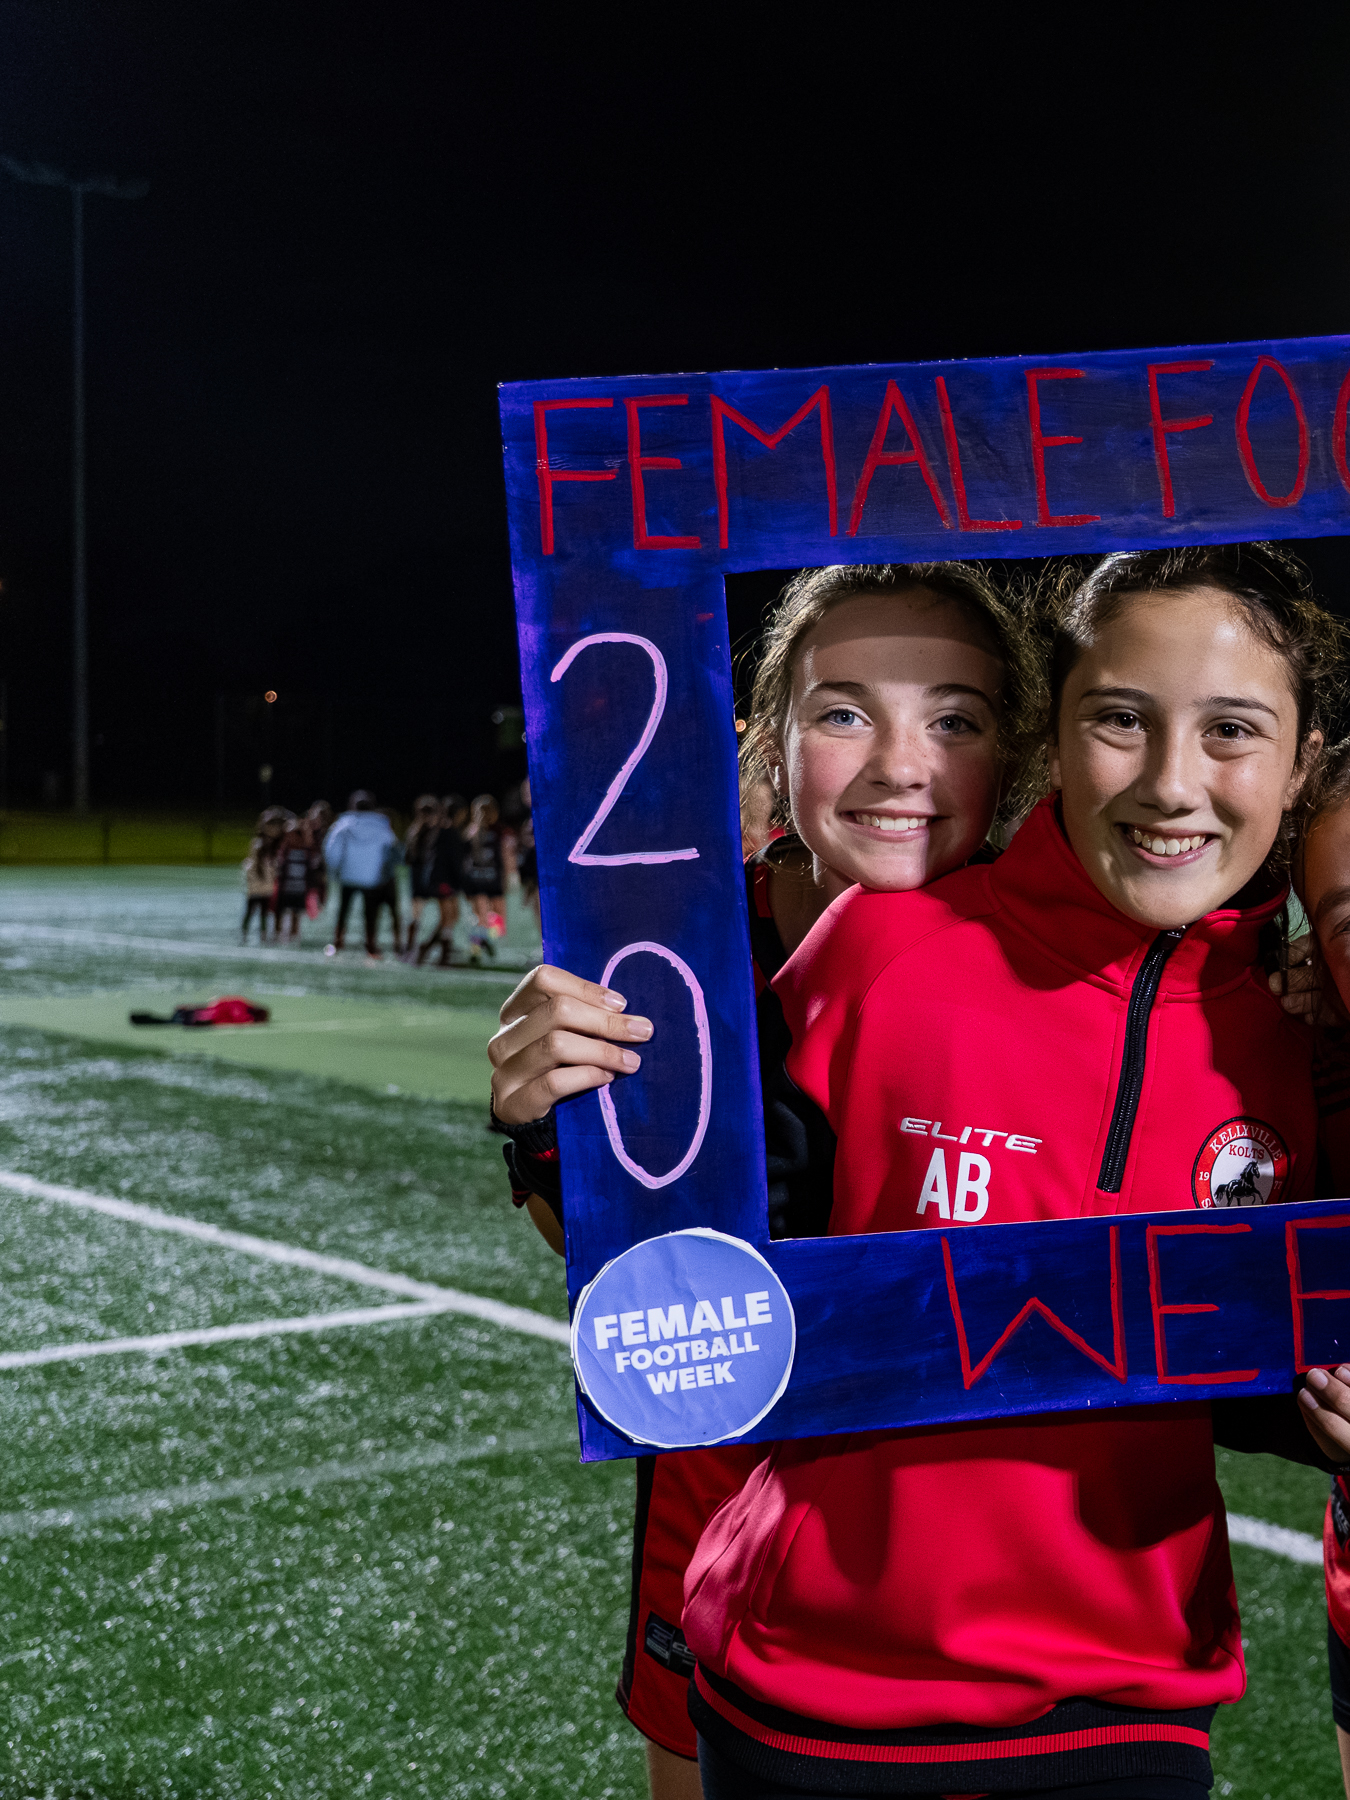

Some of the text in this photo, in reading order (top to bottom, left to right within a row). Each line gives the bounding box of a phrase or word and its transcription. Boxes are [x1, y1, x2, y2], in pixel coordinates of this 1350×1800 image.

[535, 369, 1101, 555] FEMALE
[899, 1116, 1043, 1154] ELITE
[1209, 1124, 1283, 1162] KELLYVILLE
[1228, 1144, 1265, 1160] KOLTS
[915, 1147, 992, 1223] AB
[1198, 1171, 1210, 1182] 19
[593, 1290, 773, 1351] FEMALE
[614, 1332, 760, 1374] FOOTBALL
[646, 1360, 736, 1396] WEEK
